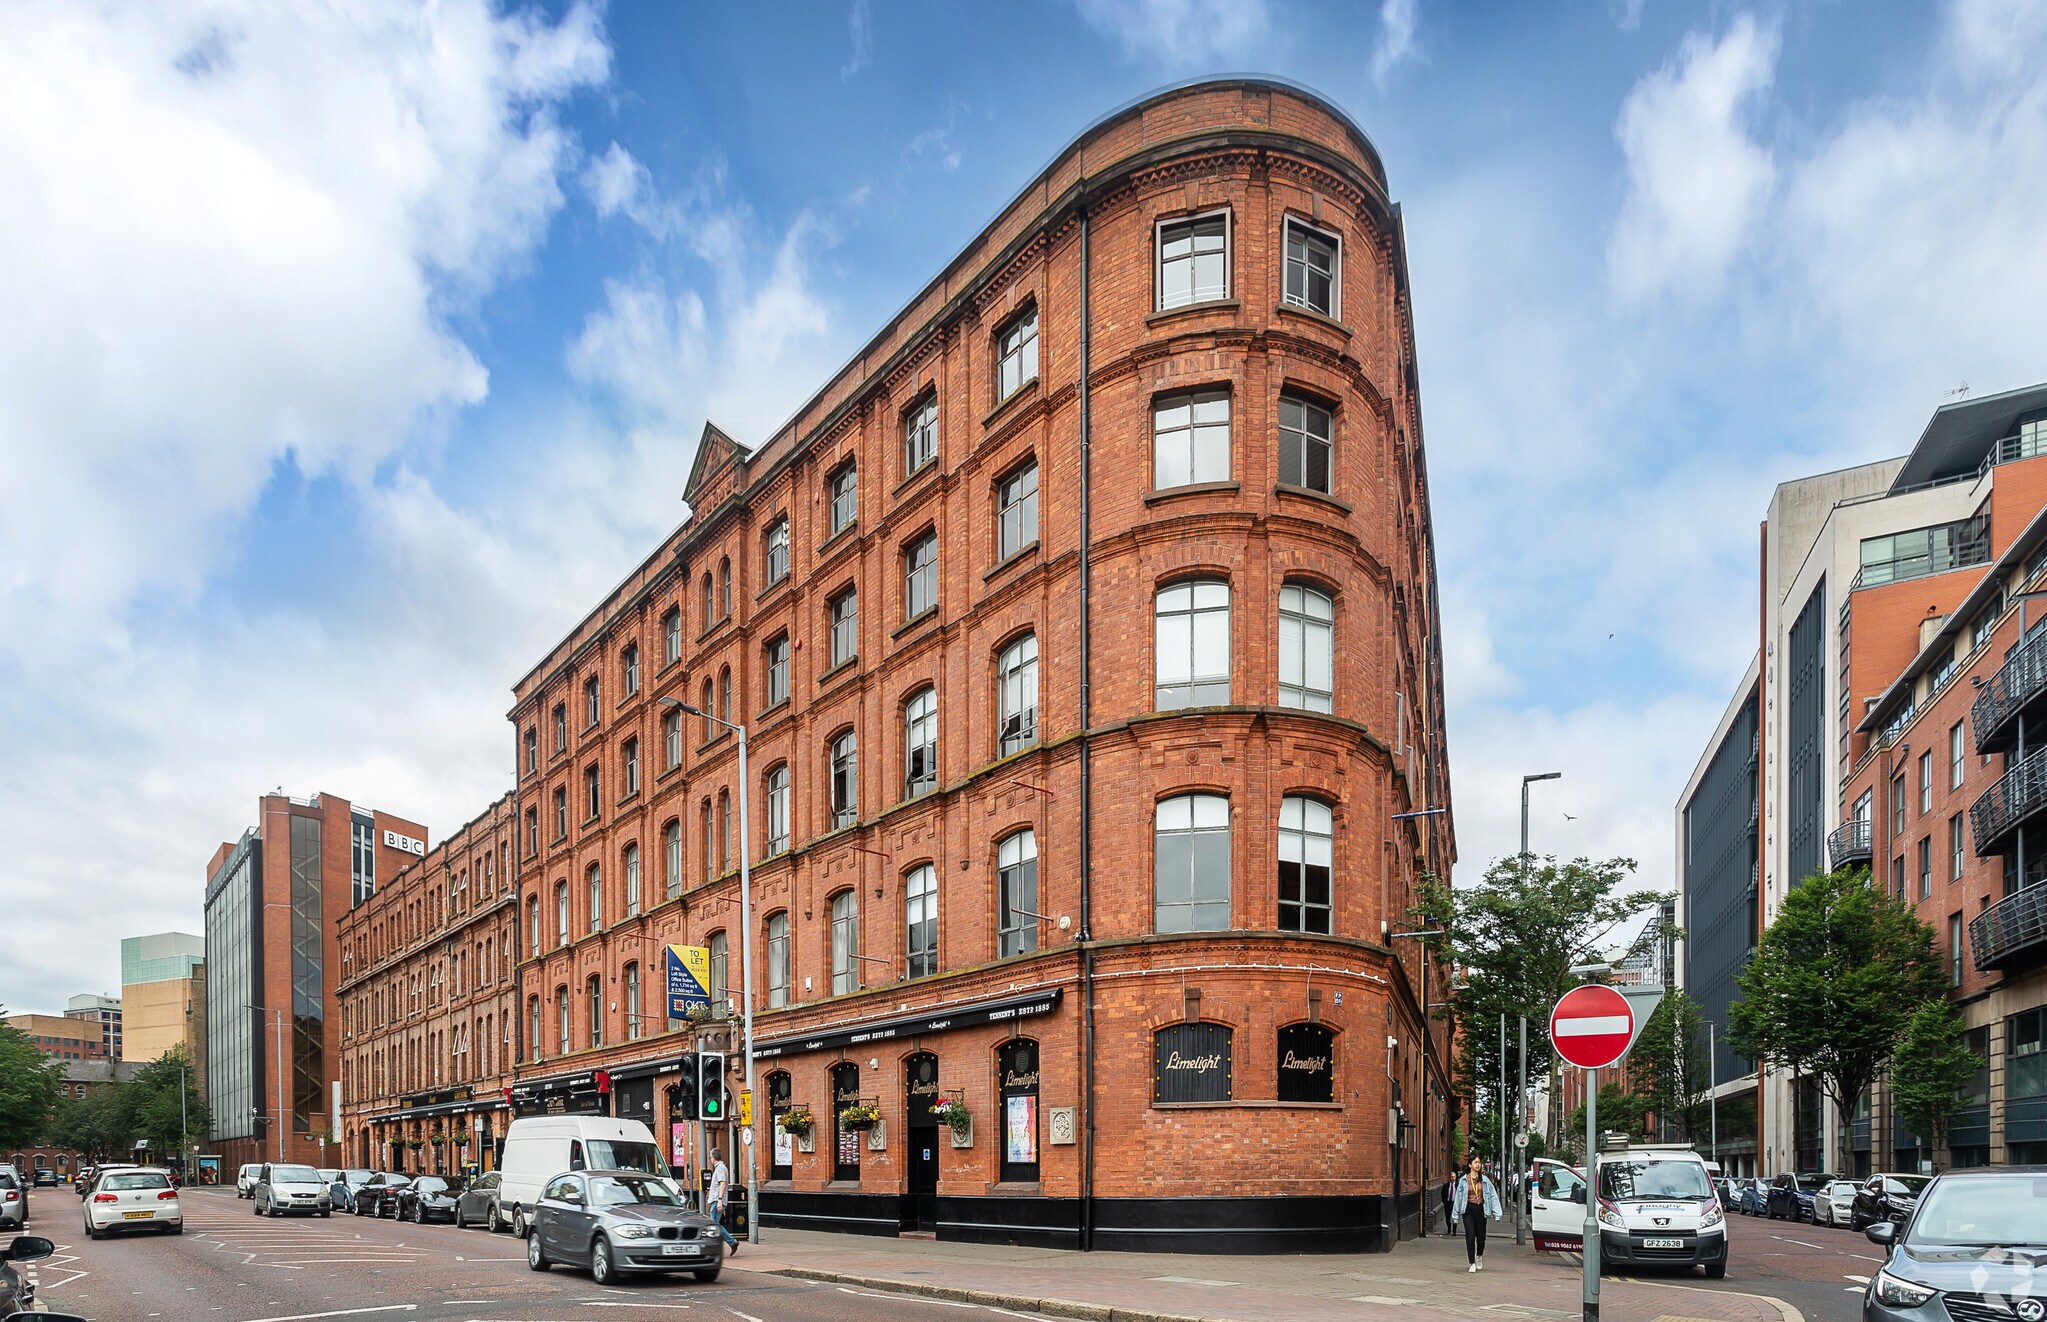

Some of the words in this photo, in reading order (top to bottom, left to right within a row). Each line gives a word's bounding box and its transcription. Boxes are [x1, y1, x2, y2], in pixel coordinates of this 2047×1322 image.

[388, 833, 422, 854] BBC
[1035, 1003, 1050, 1013] 1885
[1166, 1050, 1221, 1074] Limelight
[1282, 1050, 1327, 1075] Limelight
[1005, 1069, 1039, 1089] Limelight
[1661, 1240, 1681, 1248] 2638
